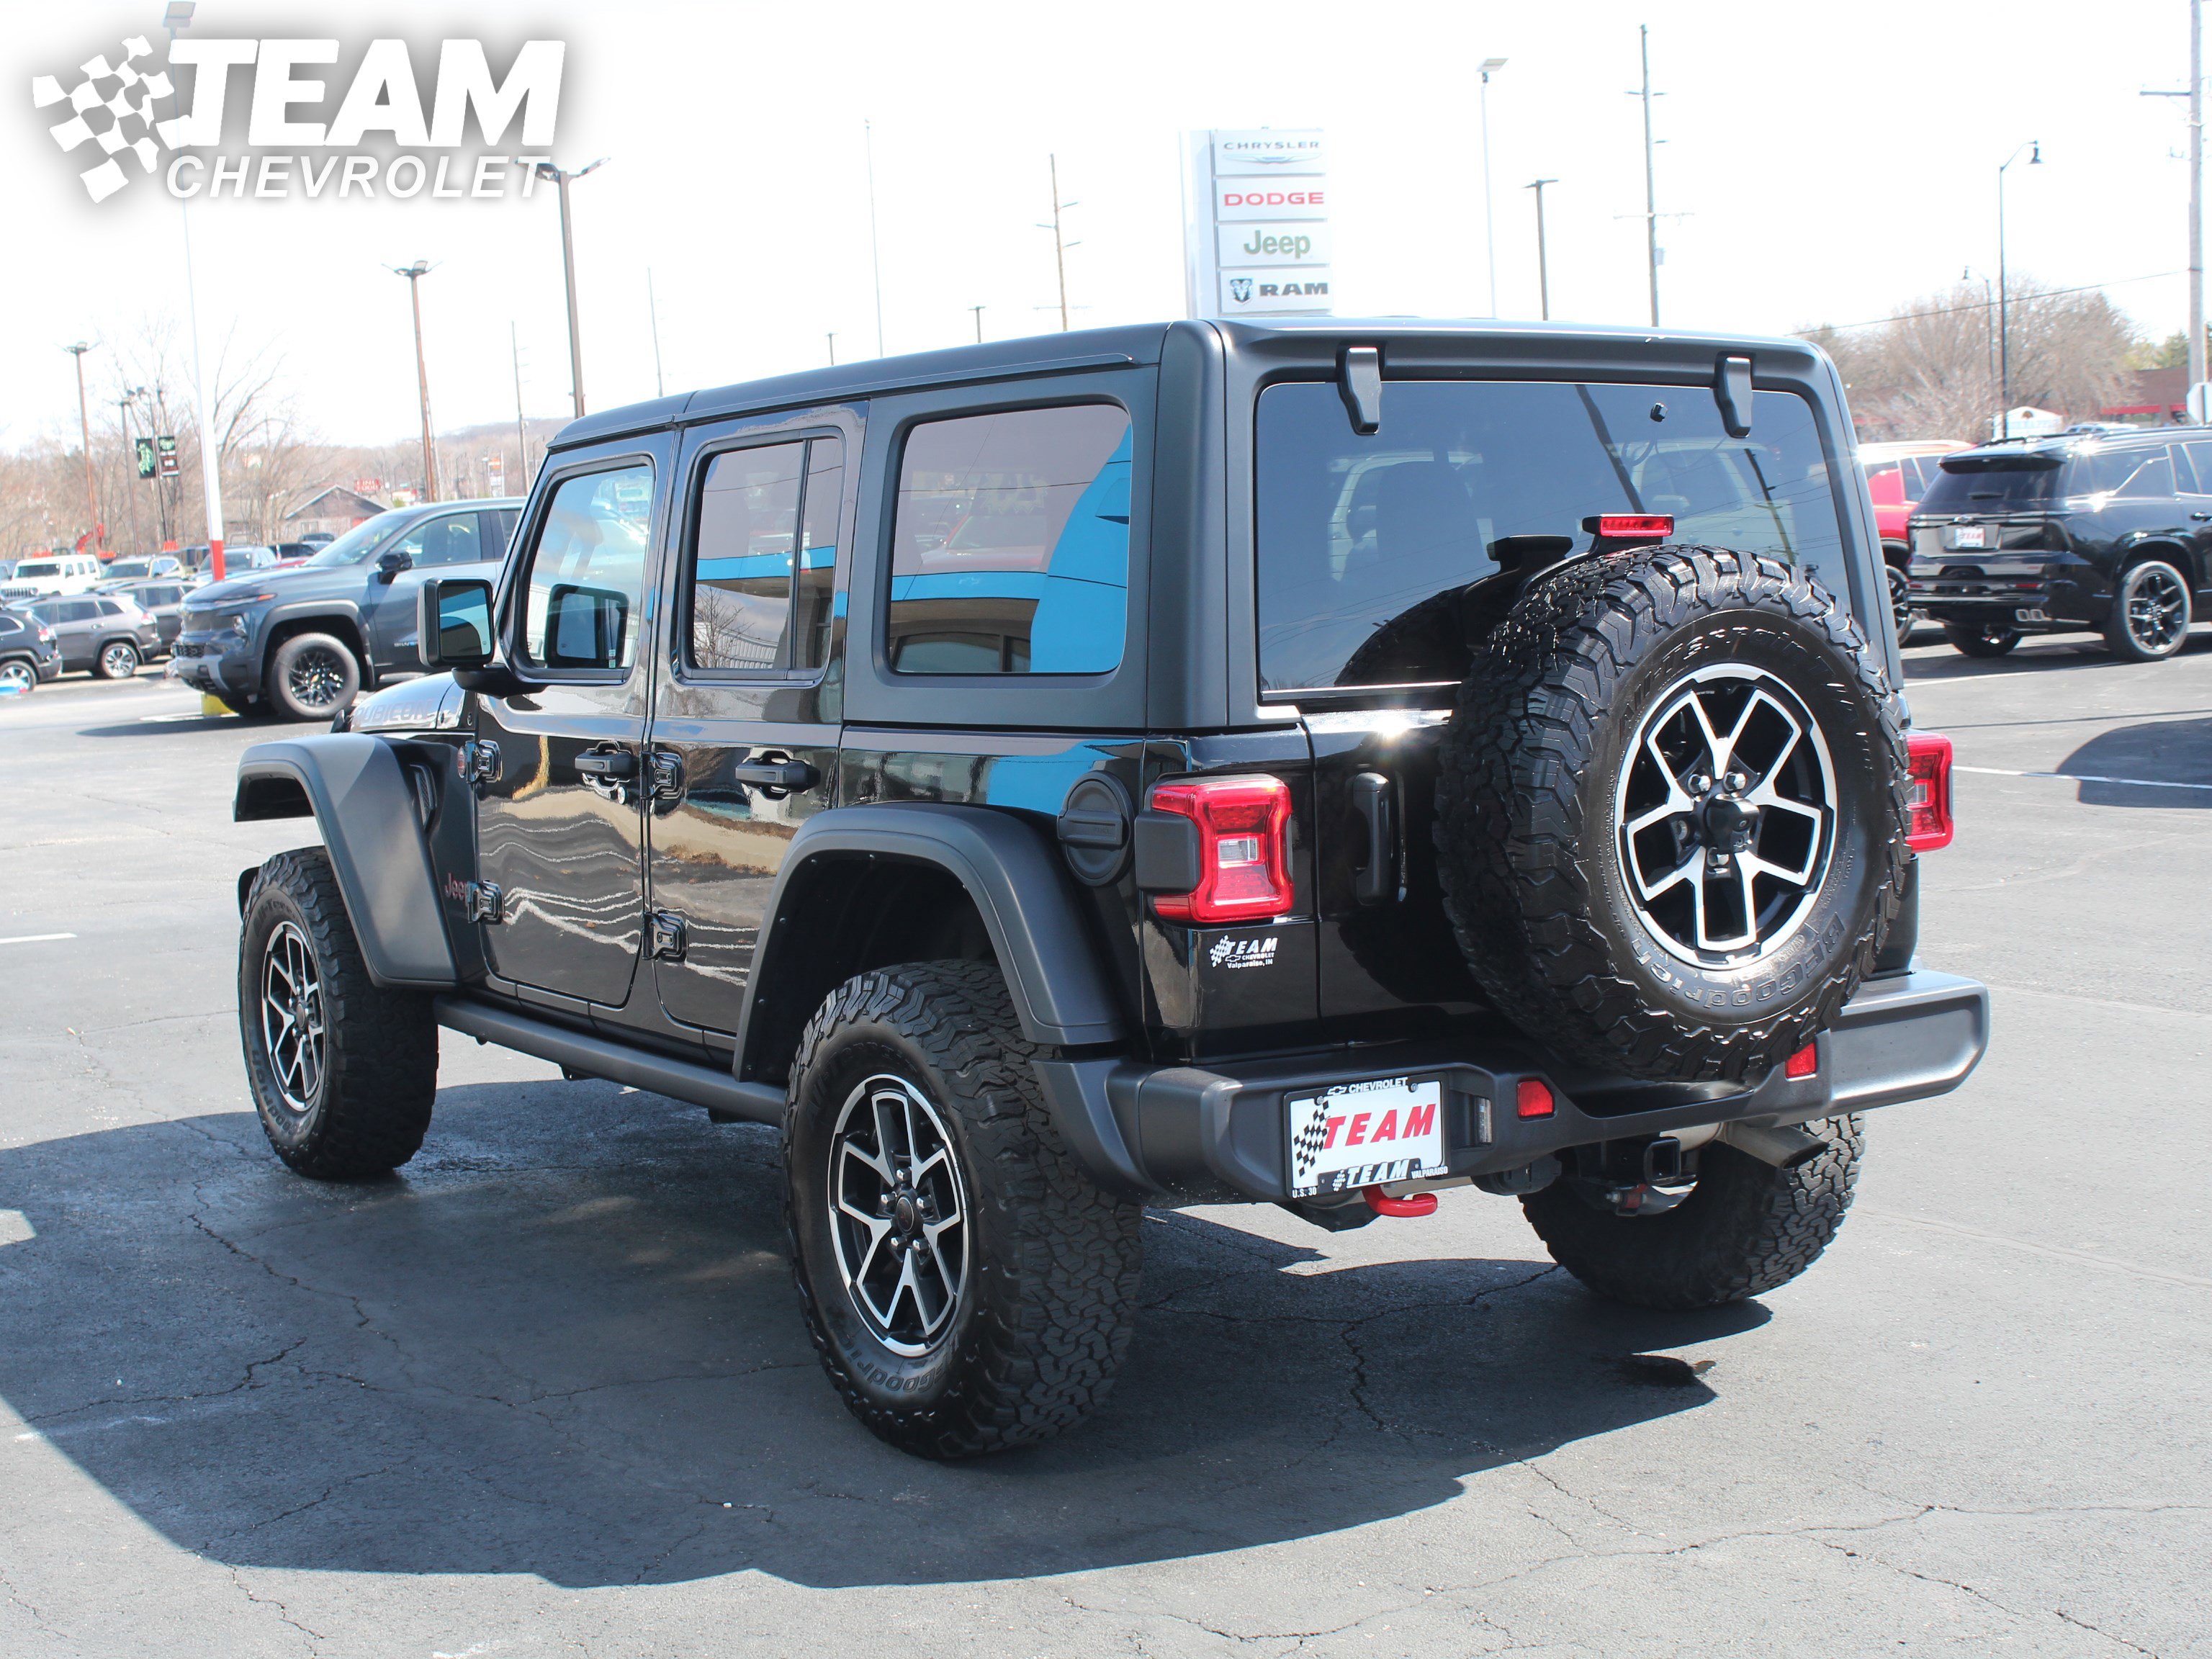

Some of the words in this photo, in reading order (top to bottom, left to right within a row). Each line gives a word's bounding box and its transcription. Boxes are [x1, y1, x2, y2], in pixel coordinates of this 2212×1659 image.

[1223, 141, 1320, 150] CHRYSLER
[1224, 192, 1325, 207] DODGE
[1244, 230, 1311, 259] Jeep
[1259, 282, 1328, 297] RAM
[1226, 938, 1278, 956] TEAM
[1241, 952, 1274, 961] CHEVROLET
[1348, 1077, 1408, 1094] CHEVROLET
[1323, 1103, 1437, 1150] TEAM
[1346, 1159, 1410, 1186] TEAM
[1411, 1166, 1449, 1179] VALPARAISO
[1292, 1188, 1307, 1198] U.S.
[1308, 1187, 1317, 1195] 30
